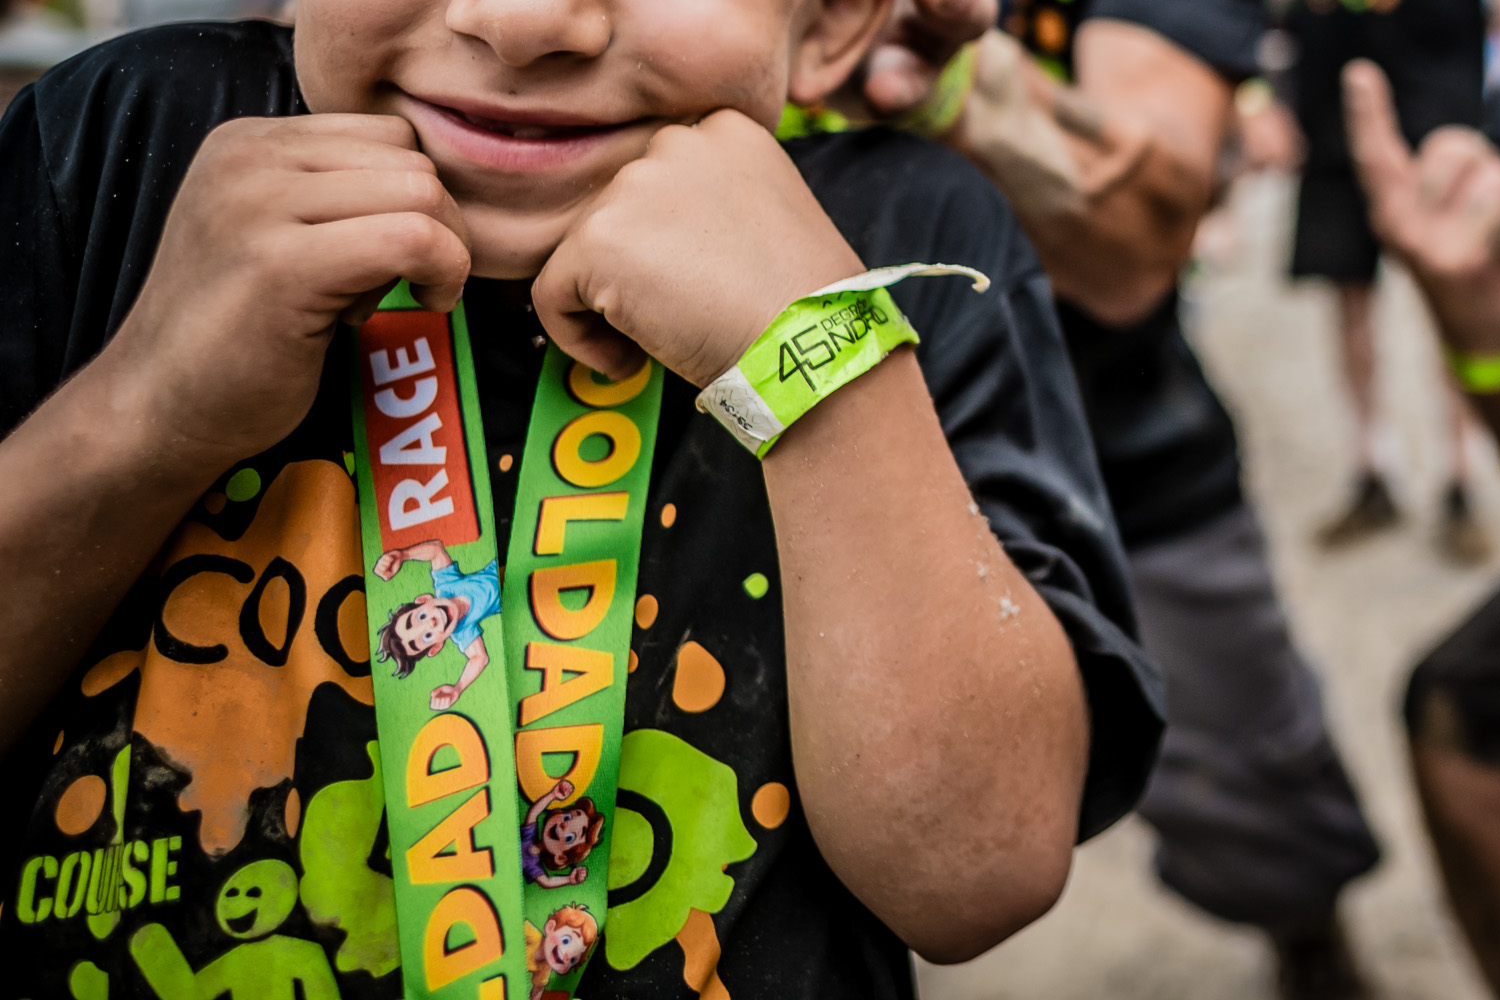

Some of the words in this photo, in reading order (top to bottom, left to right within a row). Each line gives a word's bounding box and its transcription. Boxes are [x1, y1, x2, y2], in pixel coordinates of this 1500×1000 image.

[778, 323, 837, 393] 45
[369, 337, 455, 531] RACE
[152, 552, 374, 679] COO
